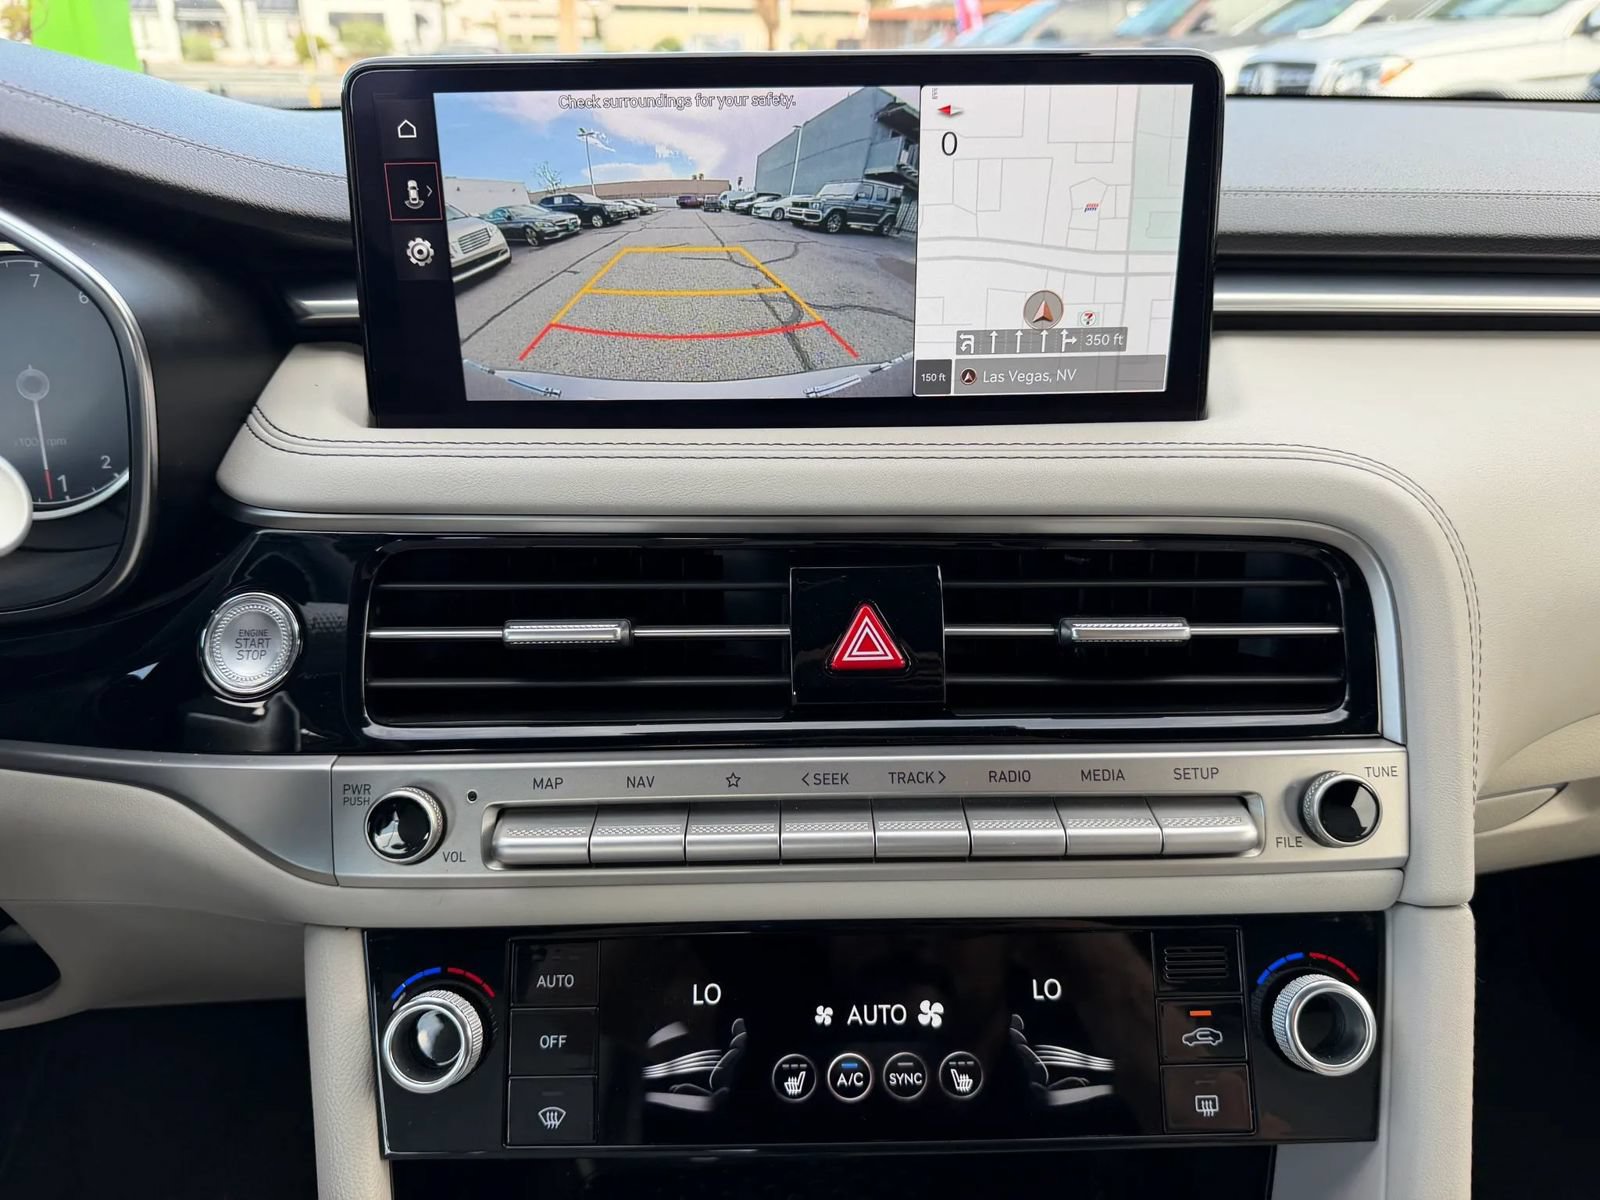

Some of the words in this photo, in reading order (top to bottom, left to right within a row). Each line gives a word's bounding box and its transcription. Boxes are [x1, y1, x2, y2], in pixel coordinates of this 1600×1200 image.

[558, 94, 600, 109] Check
[603, 93, 692, 111] surroundings
[694, 93, 715, 107] for
[717, 95, 749, 110] your
[751, 92, 797, 109] safety.
[941, 131, 958, 157] 0
[29, 273, 41, 288] 7
[78, 291, 89, 304] 6
[1085, 333, 1110, 346] 350
[1113, 333, 1124, 346] ft
[921, 373, 937, 382] 150
[938, 373, 946, 382] ft
[983, 370, 1005, 384] Las
[1008, 369, 1052, 386] Vegas,
[1056, 368, 1077, 381] NV
[100, 455, 112, 469] 2
[57, 474, 68, 492] 1
[238, 628, 270, 637] ENGINE
[235, 637, 272, 649] START
[236, 649, 267, 660] STOP
[988, 769, 1031, 783] RADIO
[1081, 768, 1126, 782] MEDIA
[1173, 767, 1219, 781] SETUP
[1364, 765, 1398, 778] TUNE
[533, 777, 564, 790] MAP
[626, 775, 655, 789] NAV
[343, 783, 371, 796] PWR
[343, 796, 371, 807] PUSH
[1275, 836, 1303, 849] FILE
[443, 851, 467, 863] VOL
[536, 974, 575, 988] AUTO
[692, 982, 722, 1006] LO
[1032, 978, 1063, 1000] LO
[847, 1003, 907, 1026] AUTO
[539, 1034, 567, 1048] OFF
[836, 1072, 864, 1088] A/C
[889, 1072, 923, 1086] SYNC
